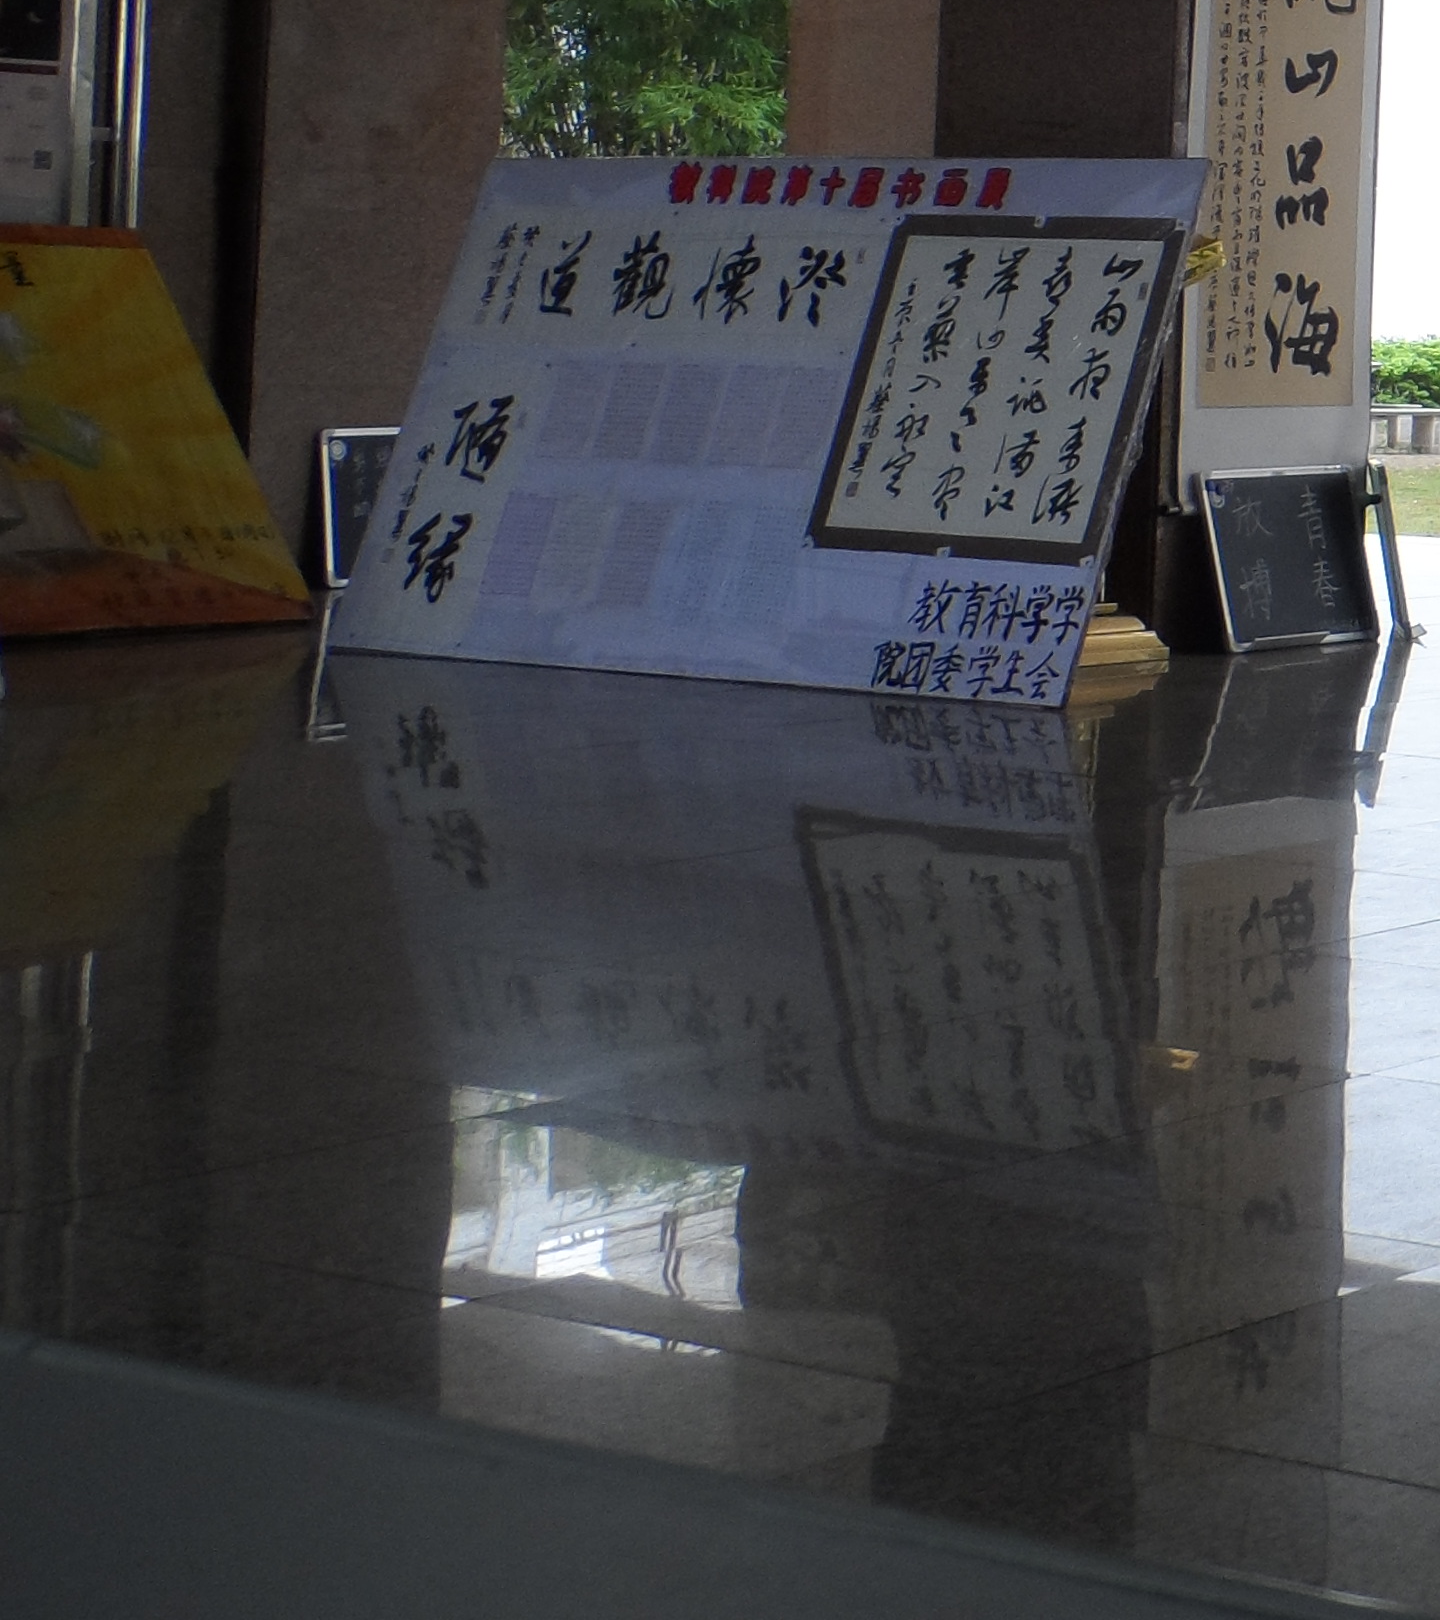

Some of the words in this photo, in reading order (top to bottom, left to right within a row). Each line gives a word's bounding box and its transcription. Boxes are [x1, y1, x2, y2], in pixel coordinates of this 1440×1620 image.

[908, 579, 1085, 646] 教育科学学
[871, 640, 1060, 700] 院团委学生会
